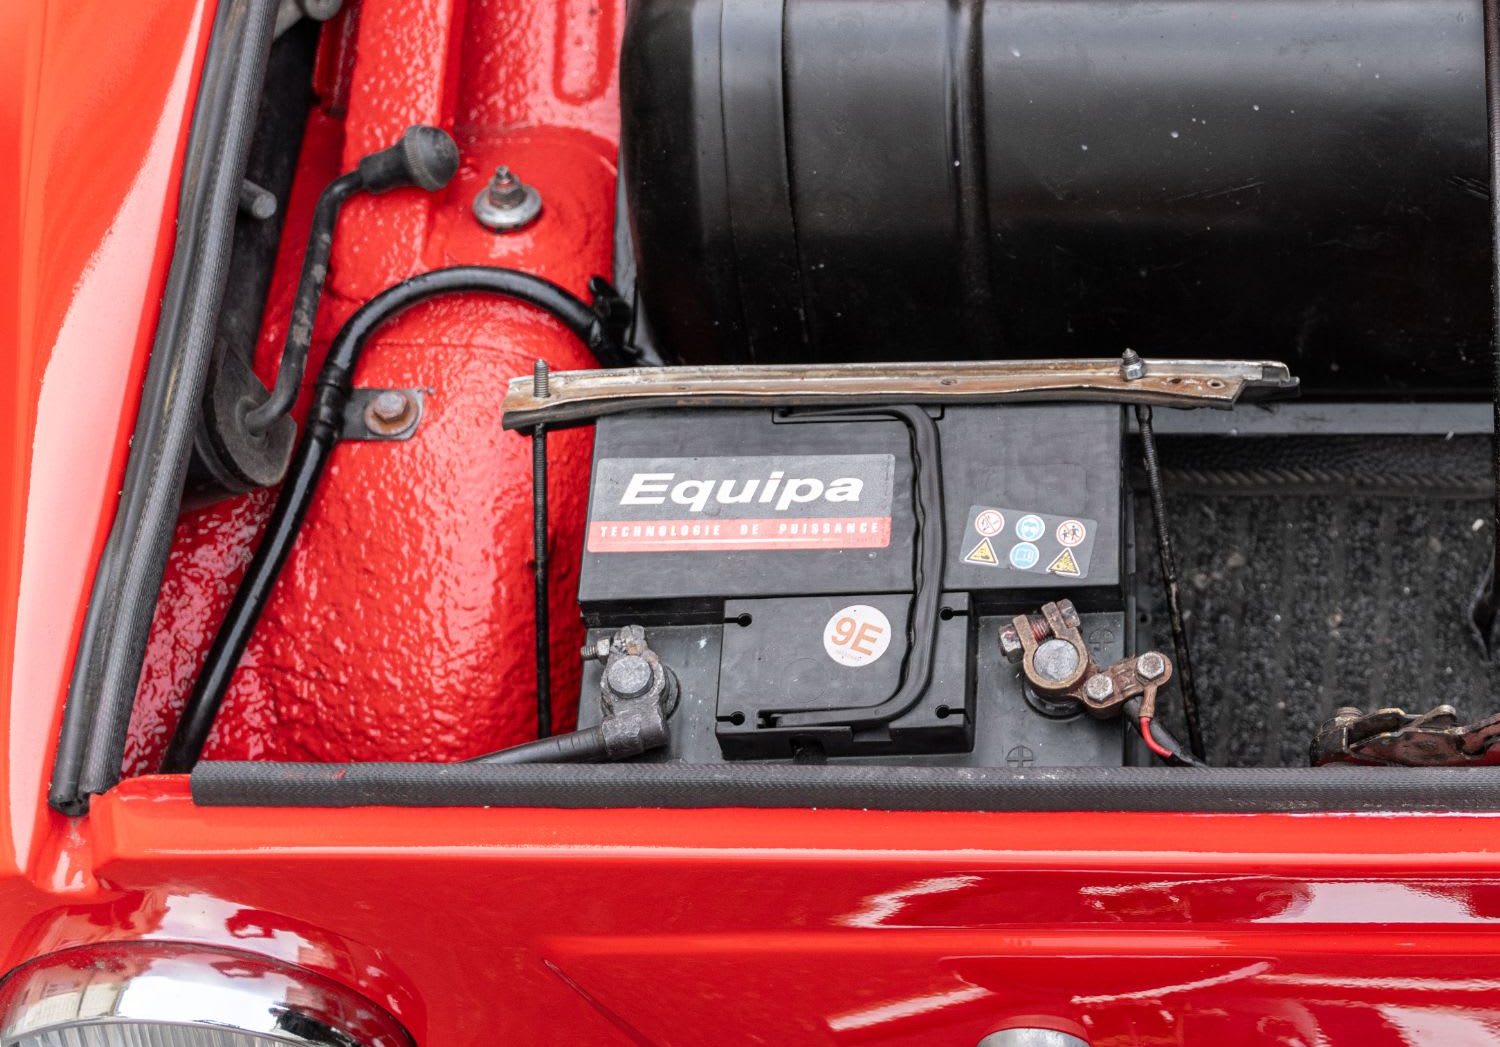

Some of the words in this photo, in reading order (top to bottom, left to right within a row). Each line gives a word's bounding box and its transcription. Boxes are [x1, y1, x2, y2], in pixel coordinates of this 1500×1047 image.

[619, 471, 864, 512] Equipa
[600, 524, 721, 537] TECHNOLOGIE
[740, 524, 759, 535] DE
[779, 521, 879, 535] PUISSANCE
[831, 616, 884, 656] 9E
